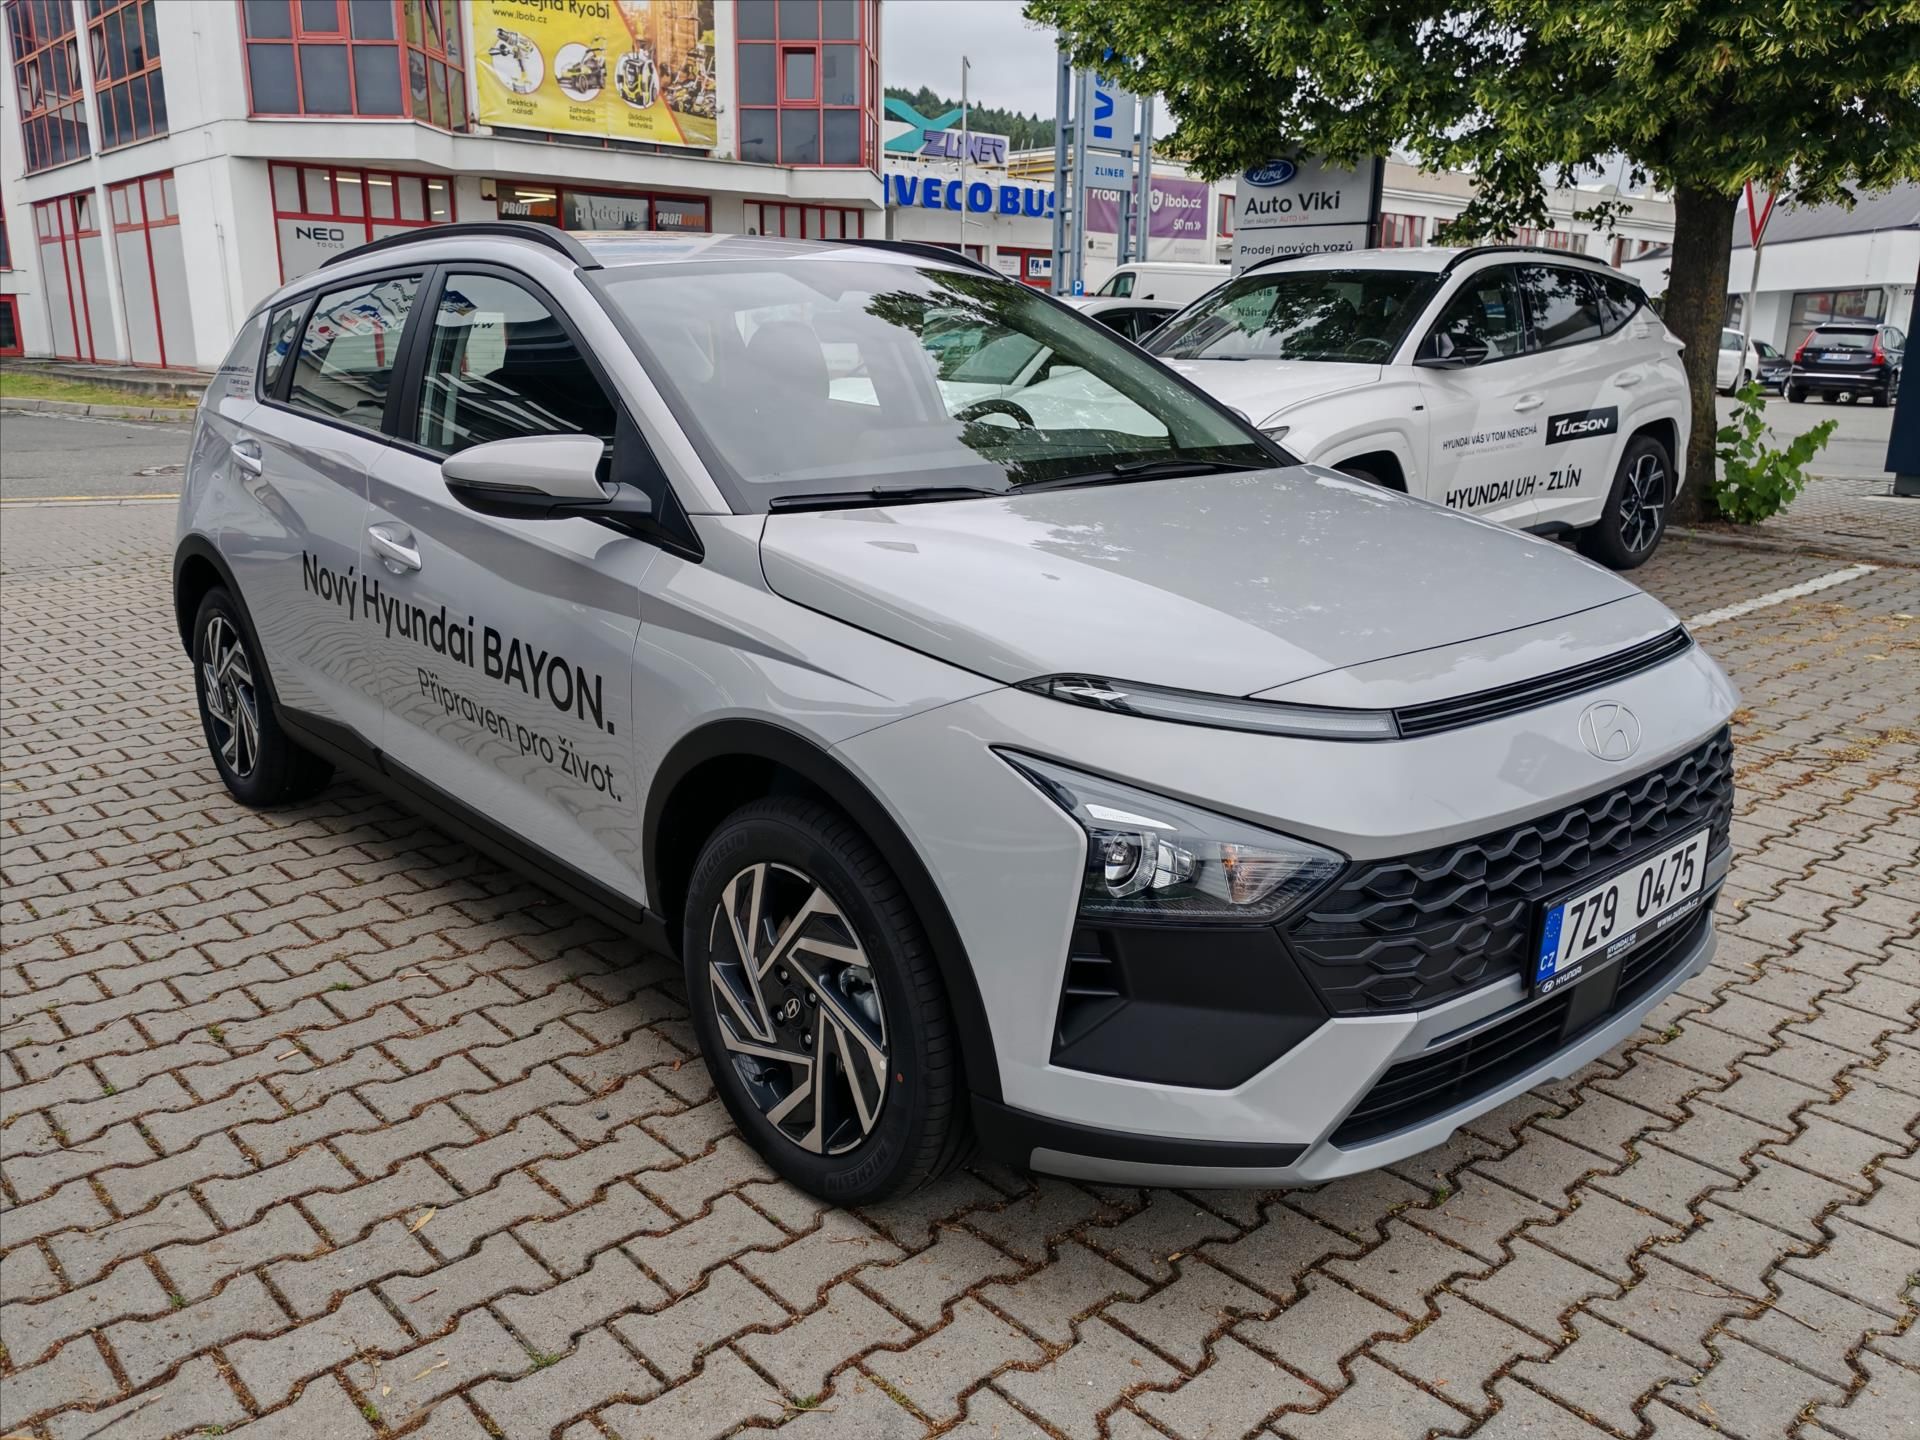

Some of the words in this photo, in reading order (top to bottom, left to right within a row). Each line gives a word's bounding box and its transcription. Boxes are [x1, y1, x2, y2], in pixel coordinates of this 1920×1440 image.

[492, 8, 547, 24] www.ibob.cz
[568, 0, 610, 20] Ryobi
[920, 129, 1007, 165] ZLINER
[1094, 166, 1125, 178] ZLINER
[1252, 161, 1284, 182] Ford
[884, 173, 993, 213] IVECO
[1164, 193, 1202, 209] ibob.cz
[1244, 196, 1292, 216] Auto
[1298, 190, 1341, 212] Viki
[296, 226, 345, 242] NEO
[1172, 218, 1184, 231] 50
[316, 241, 345, 249] TOOLS
[1240, 245, 1275, 256] Prodej
[1277, 242, 1320, 254] nových
[1322, 240, 1353, 253] vozů
[1074, 280, 1083, 296] P
[1443, 436, 1471, 450] HYUNDAI
[1471, 431, 1485, 445] VÁS
[1486, 432, 1491, 442] V
[1491, 430, 1506, 442] TOM
[1507, 422, 1538, 439] NENECHÁ
[1446, 479, 1515, 510] HYUNDAI
[1515, 475, 1537, 498] UH
[1546, 464, 1582, 491] ZLÍN
[302, 550, 357, 622] Nový
[361, 575, 475, 669] Hyundai
[483, 625, 616, 736] BAYON.
[417, 667, 513, 743] Připraven
[516, 722, 554, 764] pro
[557, 735, 623, 803] život.
[1564, 885, 1619, 961] 7Z9
[1636, 841, 1698, 919] 0475
[1539, 951, 1556, 972] CZ
[1555, 965, 1583, 986] HYUNDAI
